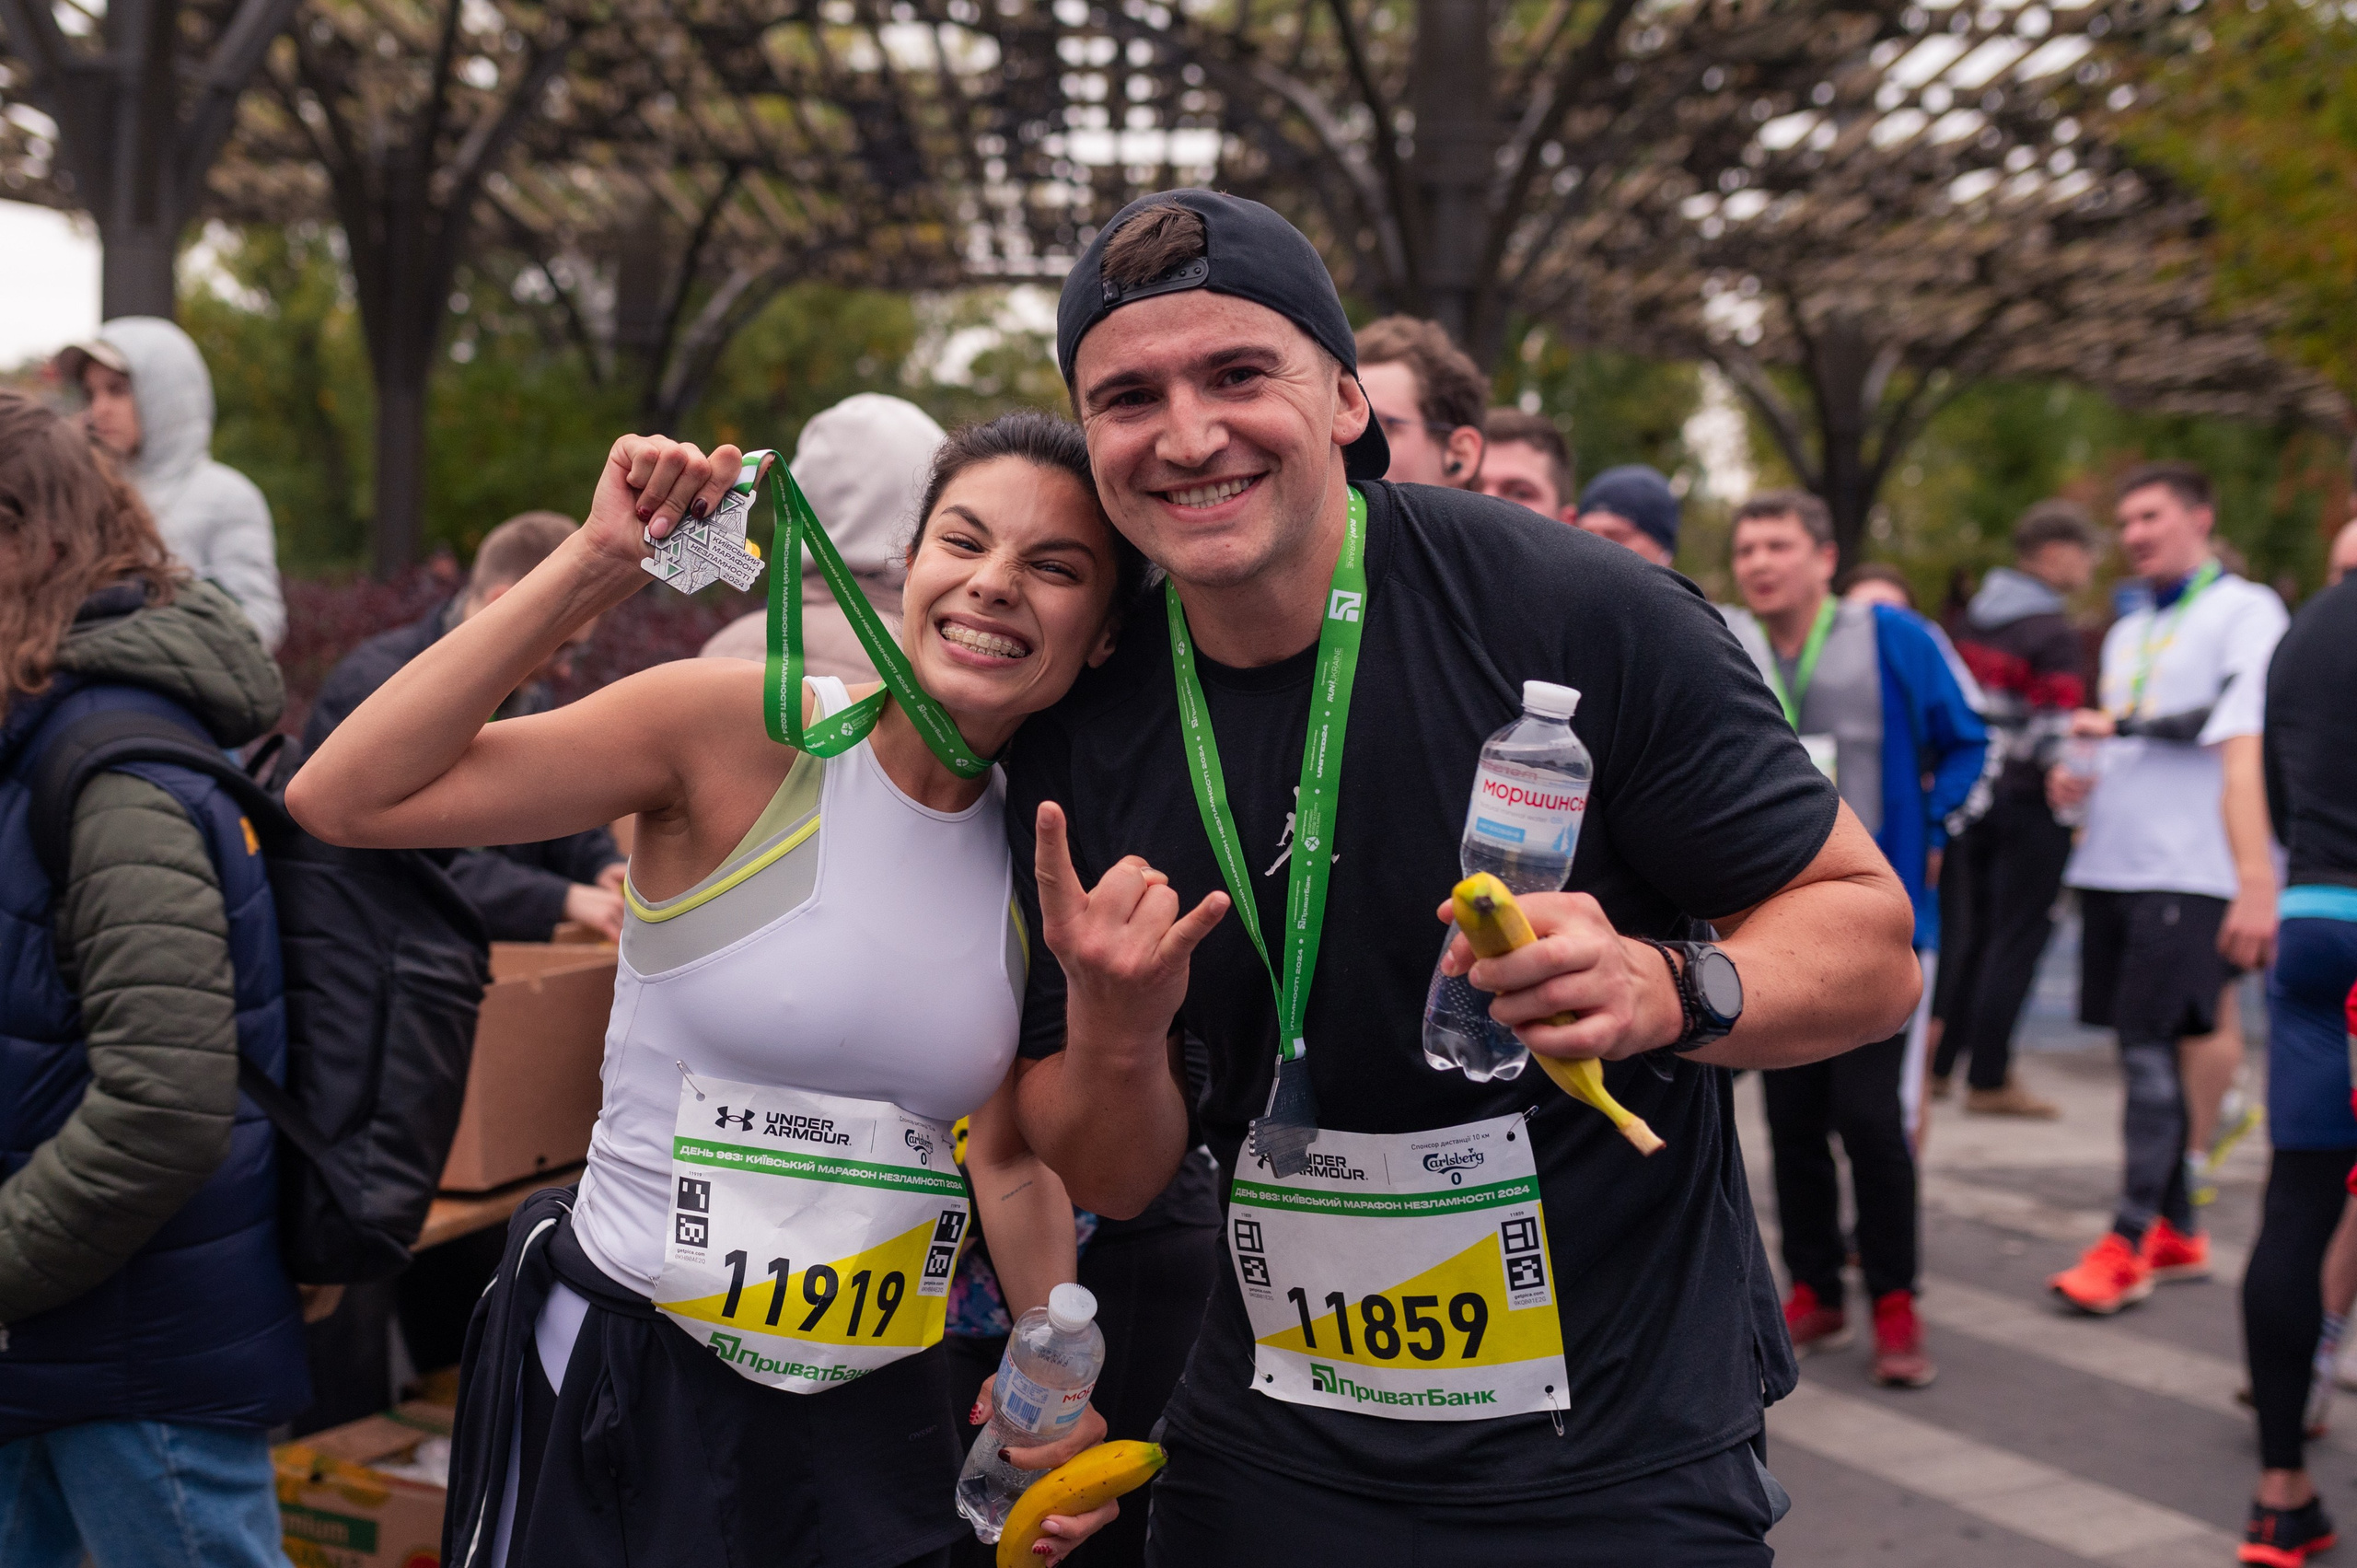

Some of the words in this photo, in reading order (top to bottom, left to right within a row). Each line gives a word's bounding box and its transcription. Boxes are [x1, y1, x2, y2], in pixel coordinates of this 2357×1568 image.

[691, 543, 750, 581] НЕЗЛАМНОСТІ
[711, 544, 756, 575] МАРАФОН
[712, 536, 761, 567] КИЇВСЬКИЙ
[783, 527, 791, 585] КИЇВСЬКИЙ
[722, 573, 745, 588] 2024
[810, 531, 839, 578] КИЇВСЬКИЙ
[837, 579, 863, 619] МАРАФОН
[862, 619, 898, 673] НЕЗЛАМНОСТІ
[896, 674, 911, 693] 2024
[780, 639, 789, 710] НЕЗЛАМНОСТІ
[780, 712, 788, 734] 2024
[1198, 745, 1207, 770] 2024
[1203, 771, 1225, 839] НЕЗЛАМНОСТІ
[1223, 840, 1241, 887] МАРАФОН
[1301, 875, 1311, 921] ПриватБанк
[1290, 977, 1300, 1031] ЛАМНОСТІ
[765, 1111, 834, 1132] UNDER
[1441, 1136, 1471, 1147] дистанції
[679, 1145, 714, 1157] ДЕНЬ
[716, 1151, 743, 1162] 963:
[746, 1155, 816, 1172] КИЇВСЬКИЙ
[818, 1165, 877, 1179] МАРАФОН
[878, 1172, 946, 1188] НЕЗЛАМНОСТІ
[946, 1180, 963, 1190] 2024
[1307, 1153, 1346, 1167] DER
[1422, 1148, 1484, 1172] Carlsberg
[1235, 1188, 1258, 1199] ДЕНЬ
[1260, 1191, 1280, 1202] 963:
[1283, 1194, 1341, 1208] КИЇВСЬКИЙ
[1344, 1201, 1401, 1210] МАРАФОН
[1404, 1191, 1495, 1210] НЕЗЛАМНОСТІ
[1498, 1185, 1530, 1199] 2024
[721, 1249, 905, 1338] 11919
[1515, 1291, 1544, 1300] getpica.com
[1286, 1287, 1489, 1361] 11859
[737, 1348, 876, 1382] ПриватБан
[1339, 1377, 1498, 1408] ПриватБанк
